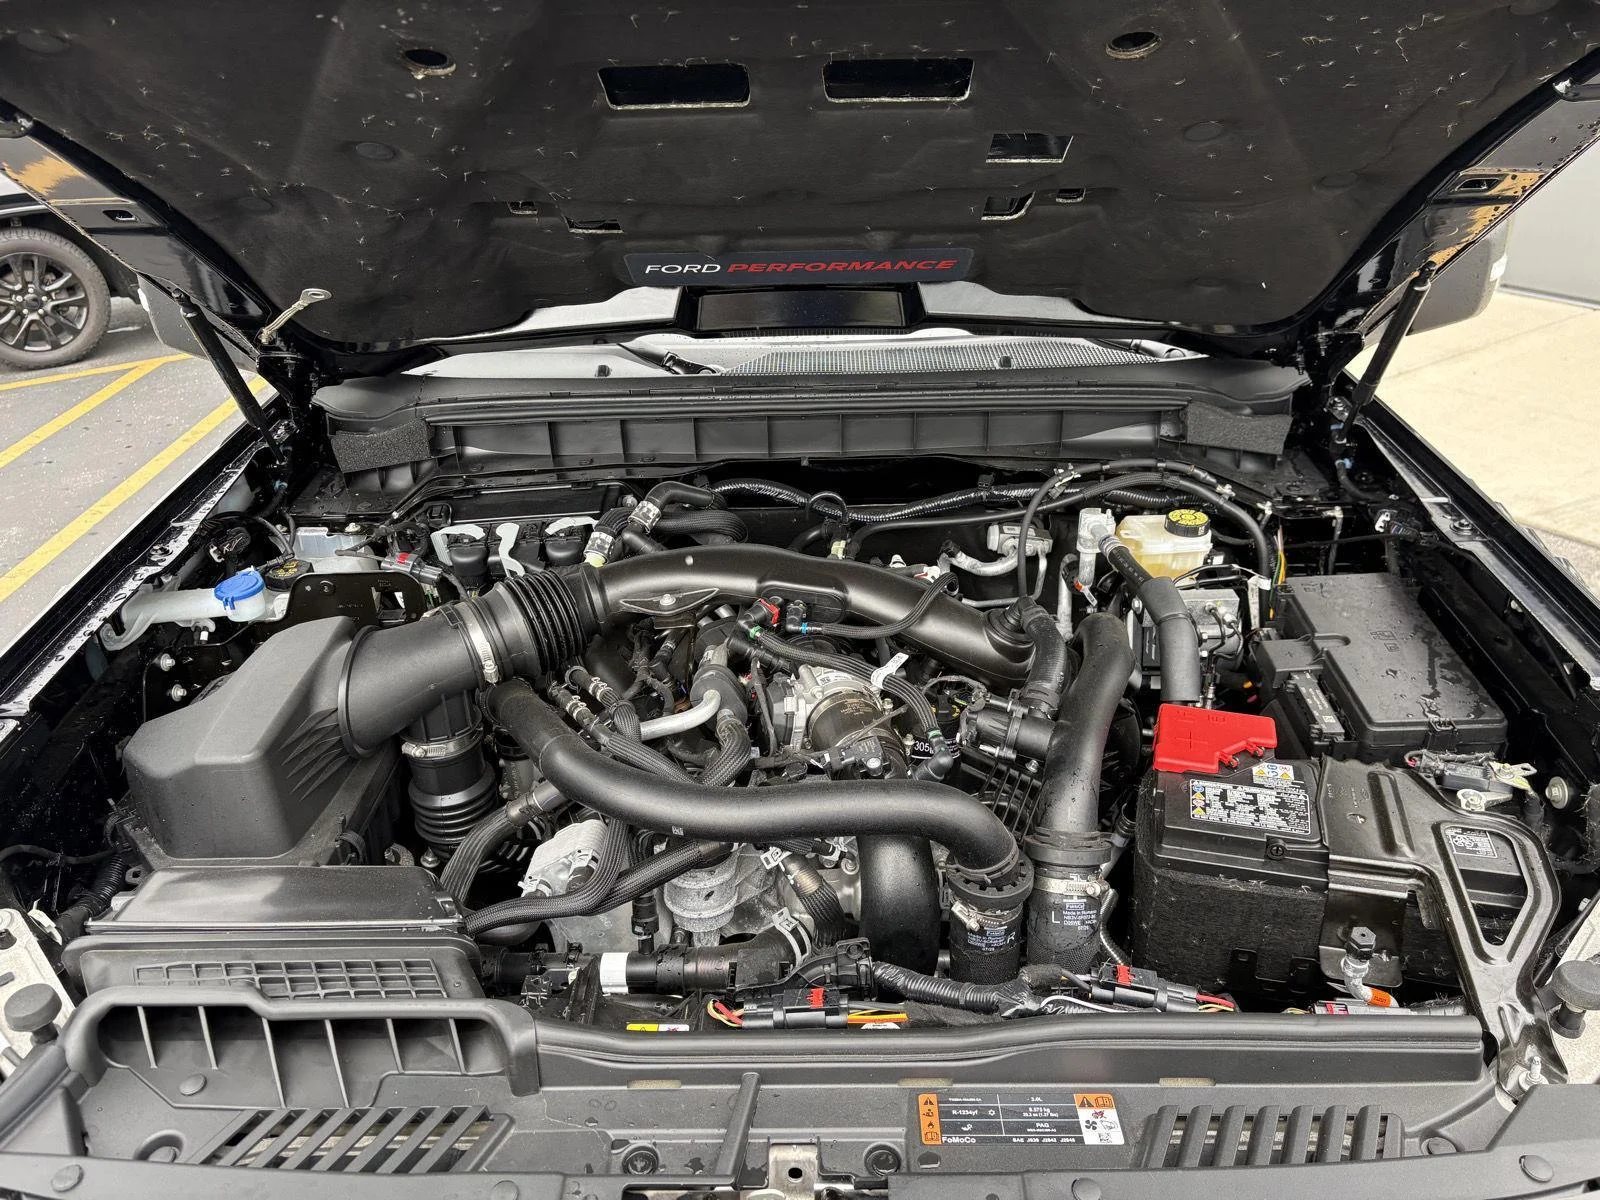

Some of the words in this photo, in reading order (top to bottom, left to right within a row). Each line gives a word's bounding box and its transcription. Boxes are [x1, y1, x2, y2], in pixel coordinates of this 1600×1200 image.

[645, 263, 721, 274] FORD
[727, 259, 959, 273] PERFORMANCE
[1051, 910, 1061, 924] L
[941, 1136, 977, 1144] FoMoCo
